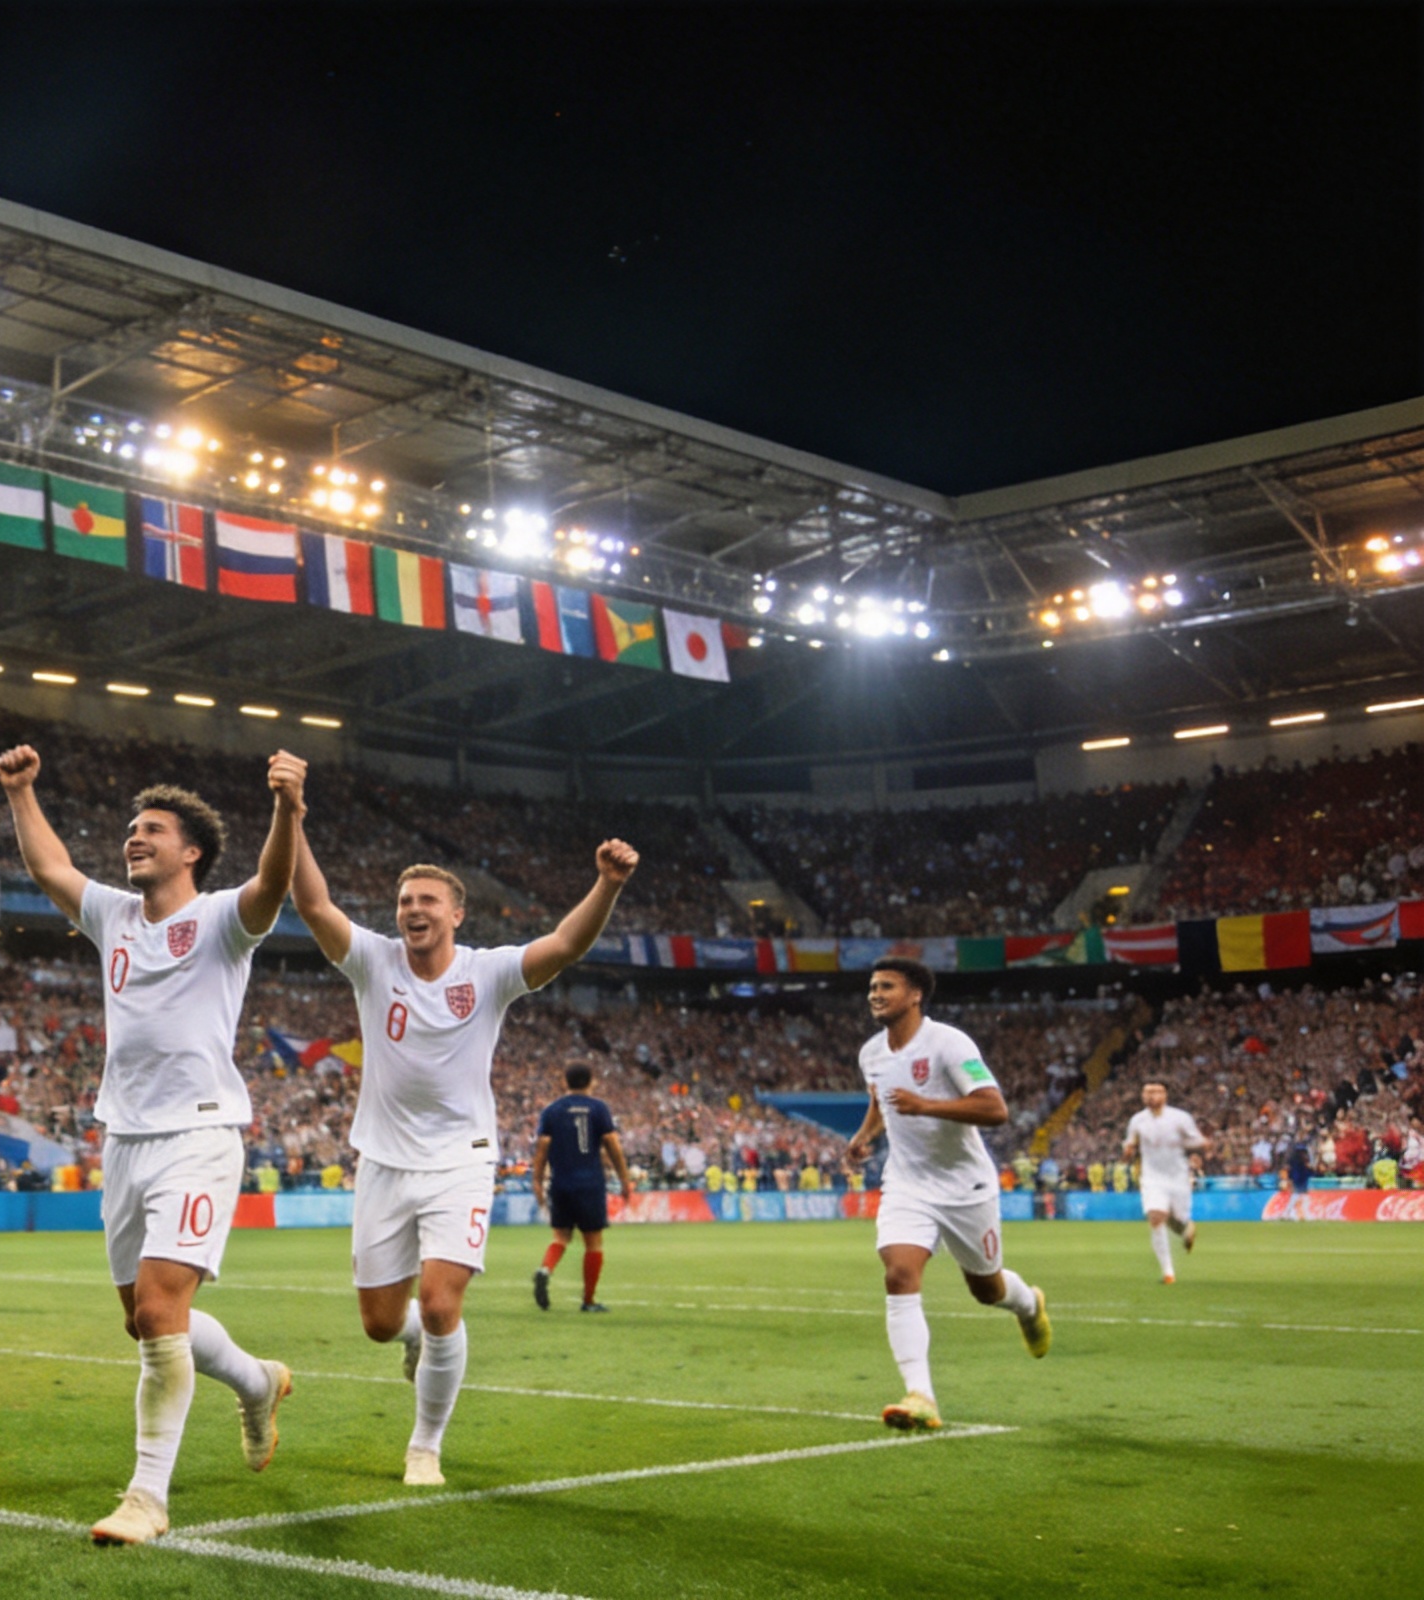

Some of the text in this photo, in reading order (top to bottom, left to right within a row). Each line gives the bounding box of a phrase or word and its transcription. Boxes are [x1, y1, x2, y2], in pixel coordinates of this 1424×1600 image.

[110, 947, 130, 994] 0
[178, 1191, 214, 1238] 10
[467, 1207, 487, 1249] 5
